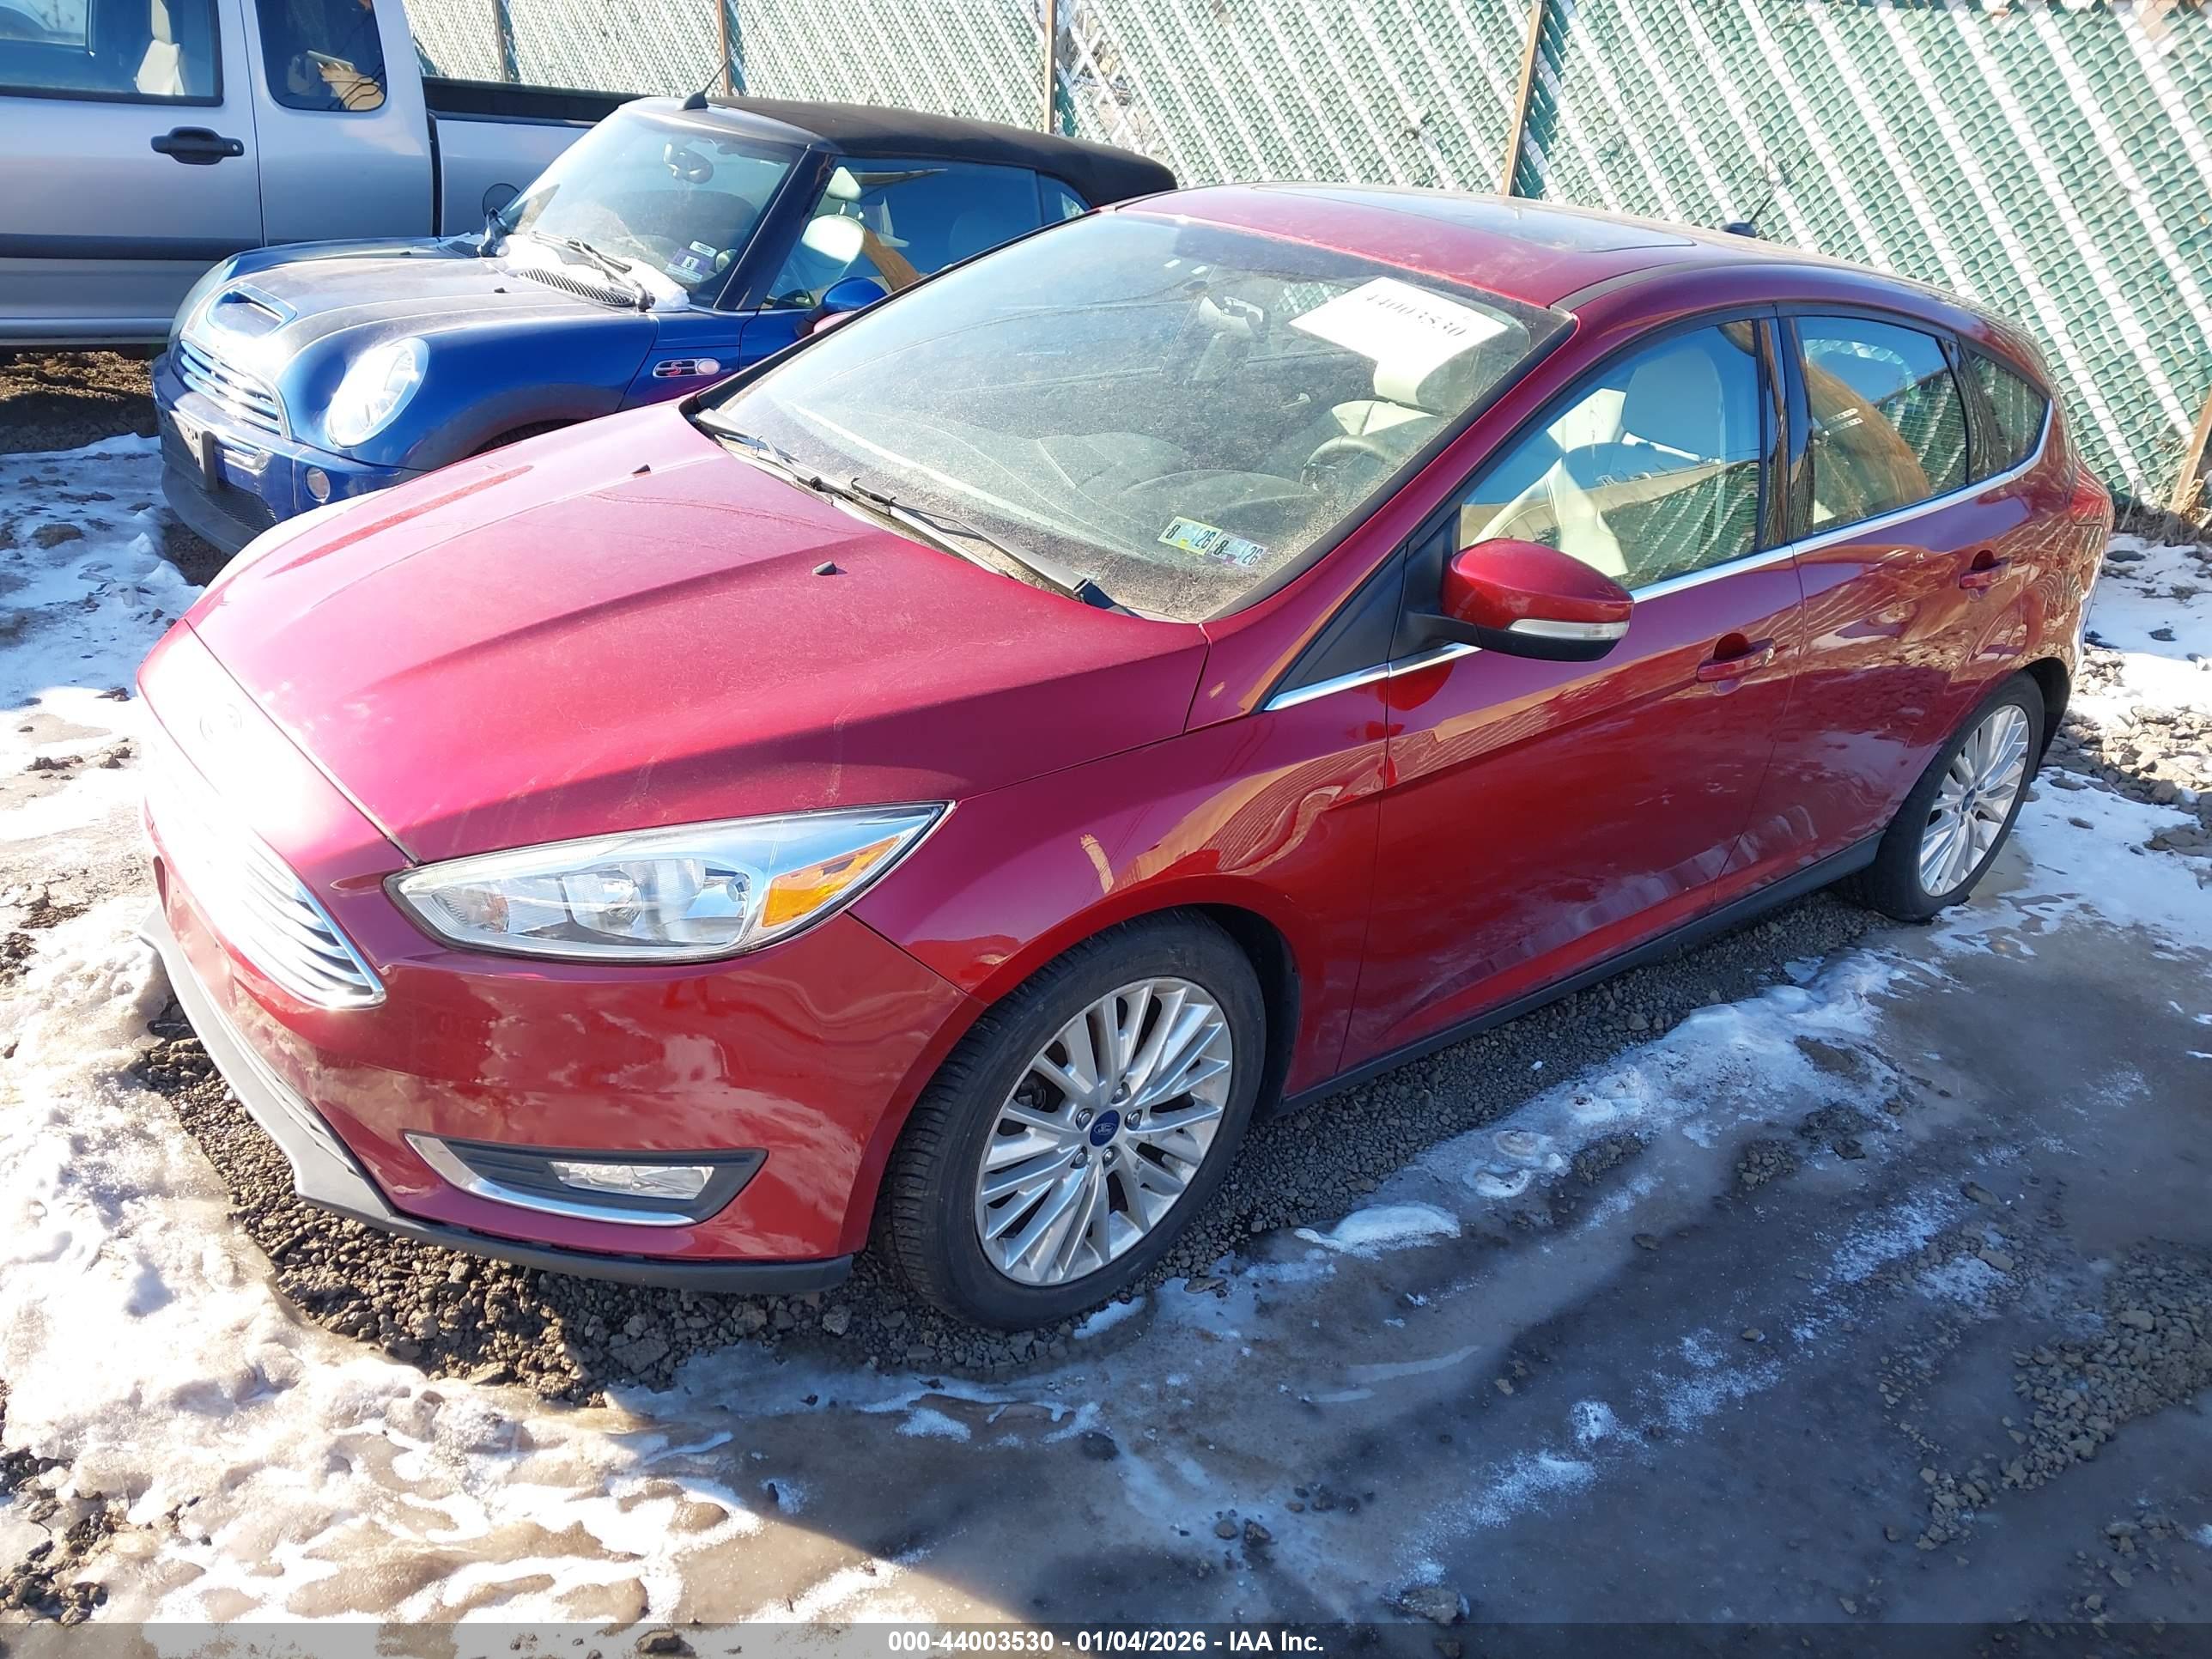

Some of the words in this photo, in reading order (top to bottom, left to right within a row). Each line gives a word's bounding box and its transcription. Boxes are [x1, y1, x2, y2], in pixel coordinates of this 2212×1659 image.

[666, 361, 682, 376] S
[1165, 524, 1182, 540] 8
[1195, 530, 1216, 549] 26
[1213, 539, 1230, 556] 8
[1242, 546, 1264, 565] 26
